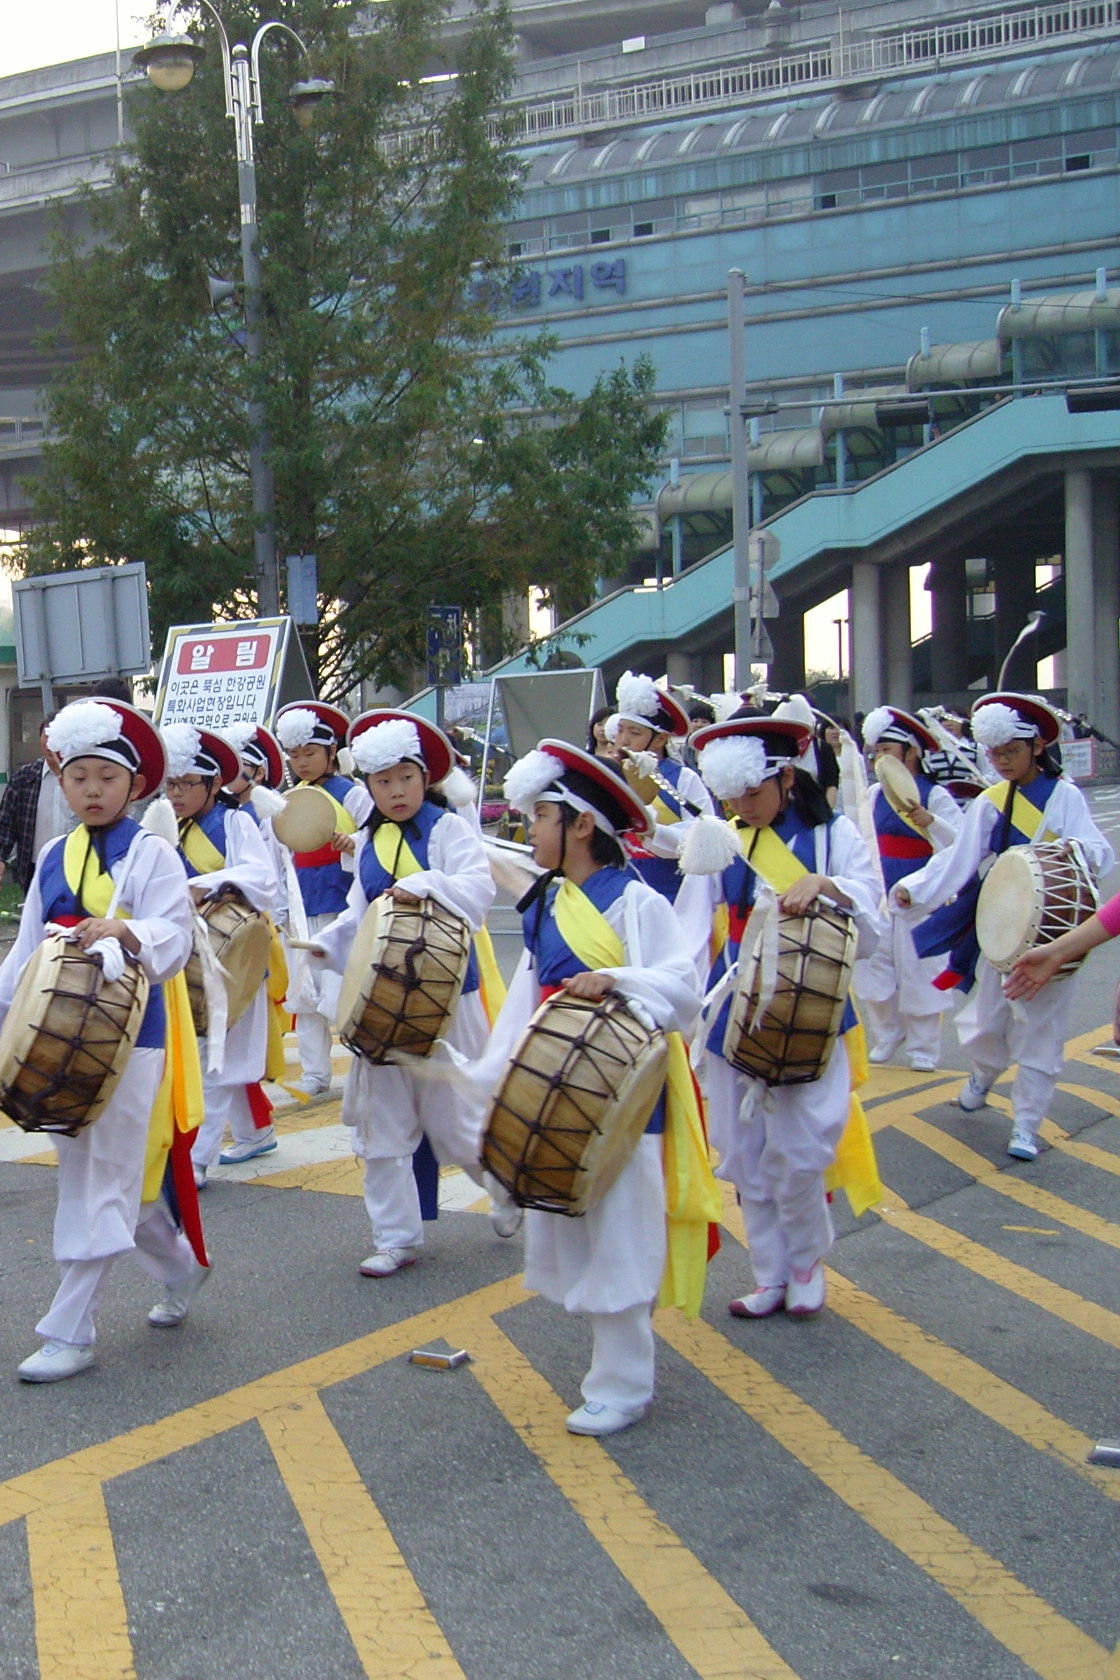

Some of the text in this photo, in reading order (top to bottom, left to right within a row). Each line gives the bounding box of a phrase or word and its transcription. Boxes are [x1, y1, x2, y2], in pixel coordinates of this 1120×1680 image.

[170, 674, 267, 696] 이곳은 뚝섬 한강공원
[167, 693, 257, 714] 특화사업현장입니다
